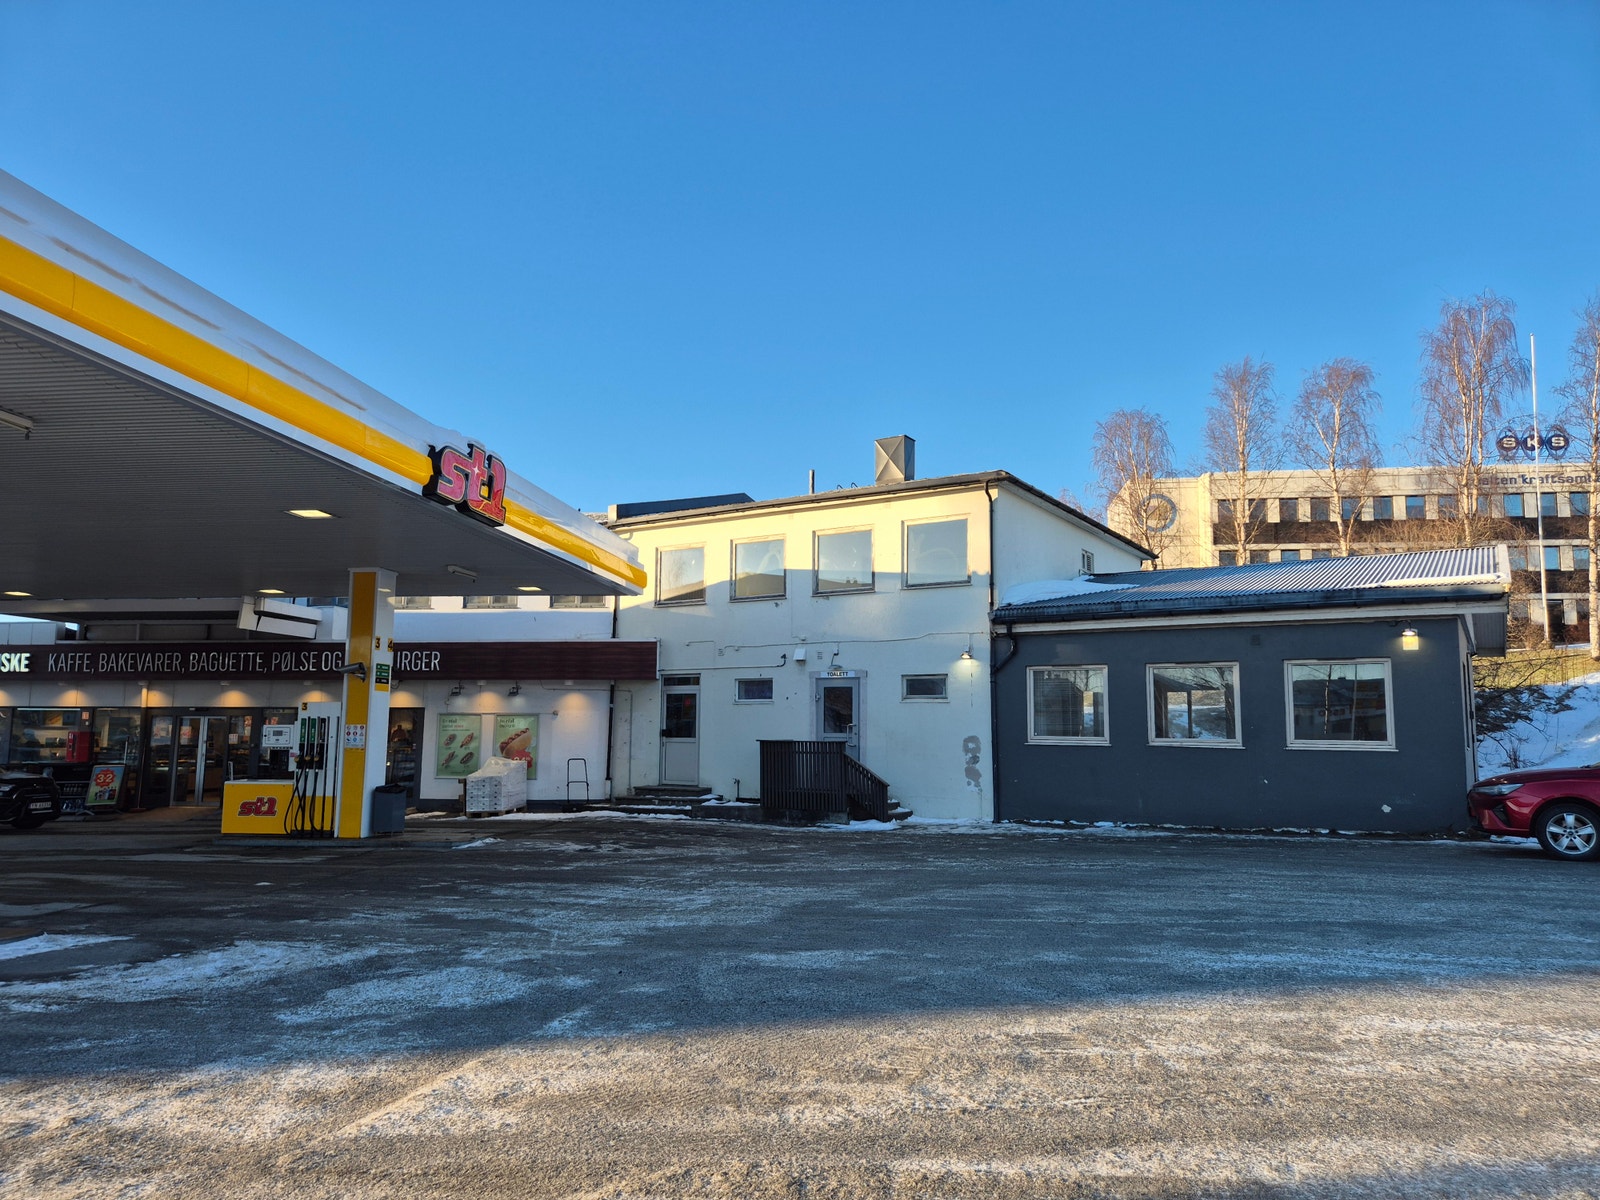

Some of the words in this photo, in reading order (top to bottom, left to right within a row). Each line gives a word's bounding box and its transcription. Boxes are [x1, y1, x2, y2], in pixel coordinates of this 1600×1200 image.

[434, 445, 507, 525] st1
[0, 653, 31, 672] SKE
[48, 653, 94, 674] KAFFE,
[99, 652, 185, 674] BAKEVARER,
[189, 652, 268, 673] BAGUETTE,
[271, 651, 318, 672] PØLSE
[321, 651, 342, 671] OG
[301, 702, 308, 711] 3
[237, 796, 278, 817] st1
